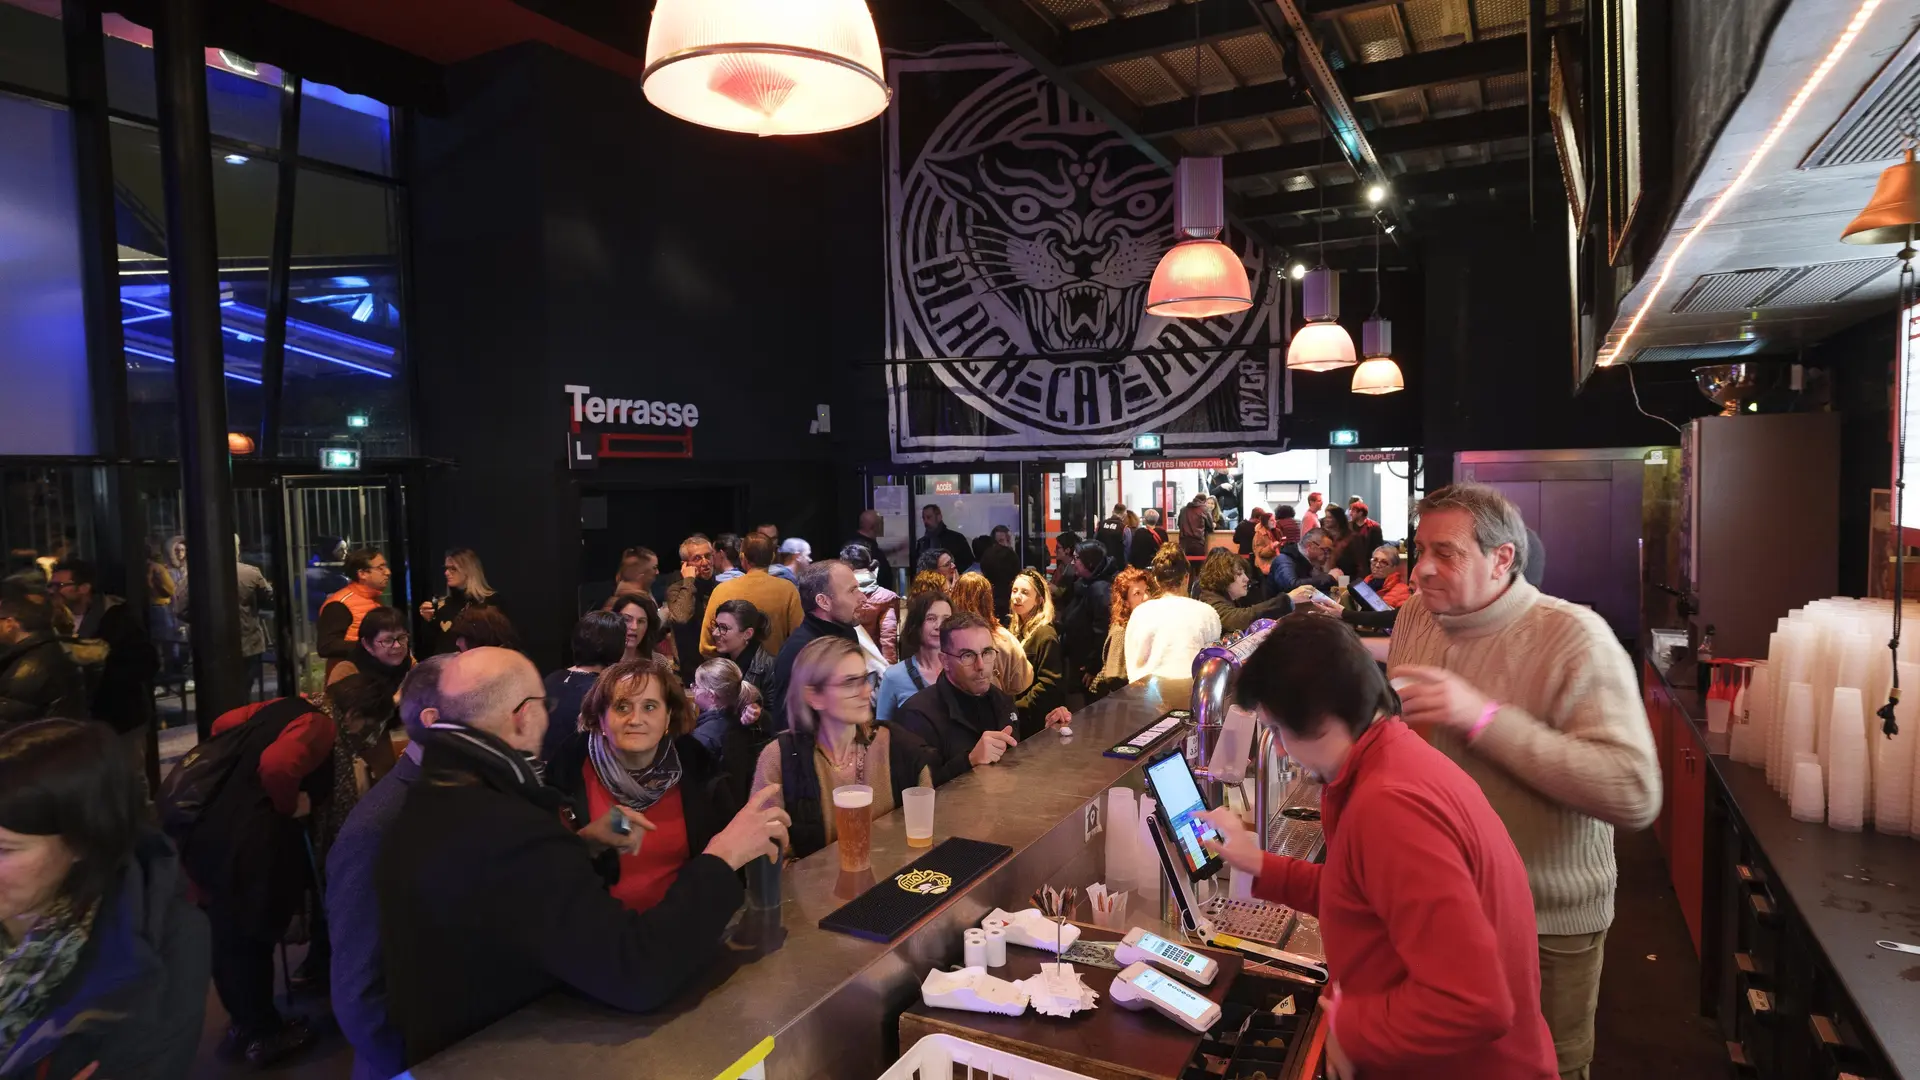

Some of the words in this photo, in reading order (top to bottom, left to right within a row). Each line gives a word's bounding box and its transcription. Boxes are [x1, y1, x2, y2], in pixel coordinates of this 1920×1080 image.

[913, 256, 1030, 399] BLACK
[1046, 363, 1126, 426] CAT
[565, 384, 699, 428] Terrasse
[576, 441, 592, 460] L
[1359, 453, 1396, 461] COMPLET
[1146, 460, 1175, 469] VENTES
[1178, 459, 1223, 468] INVITATIONS
